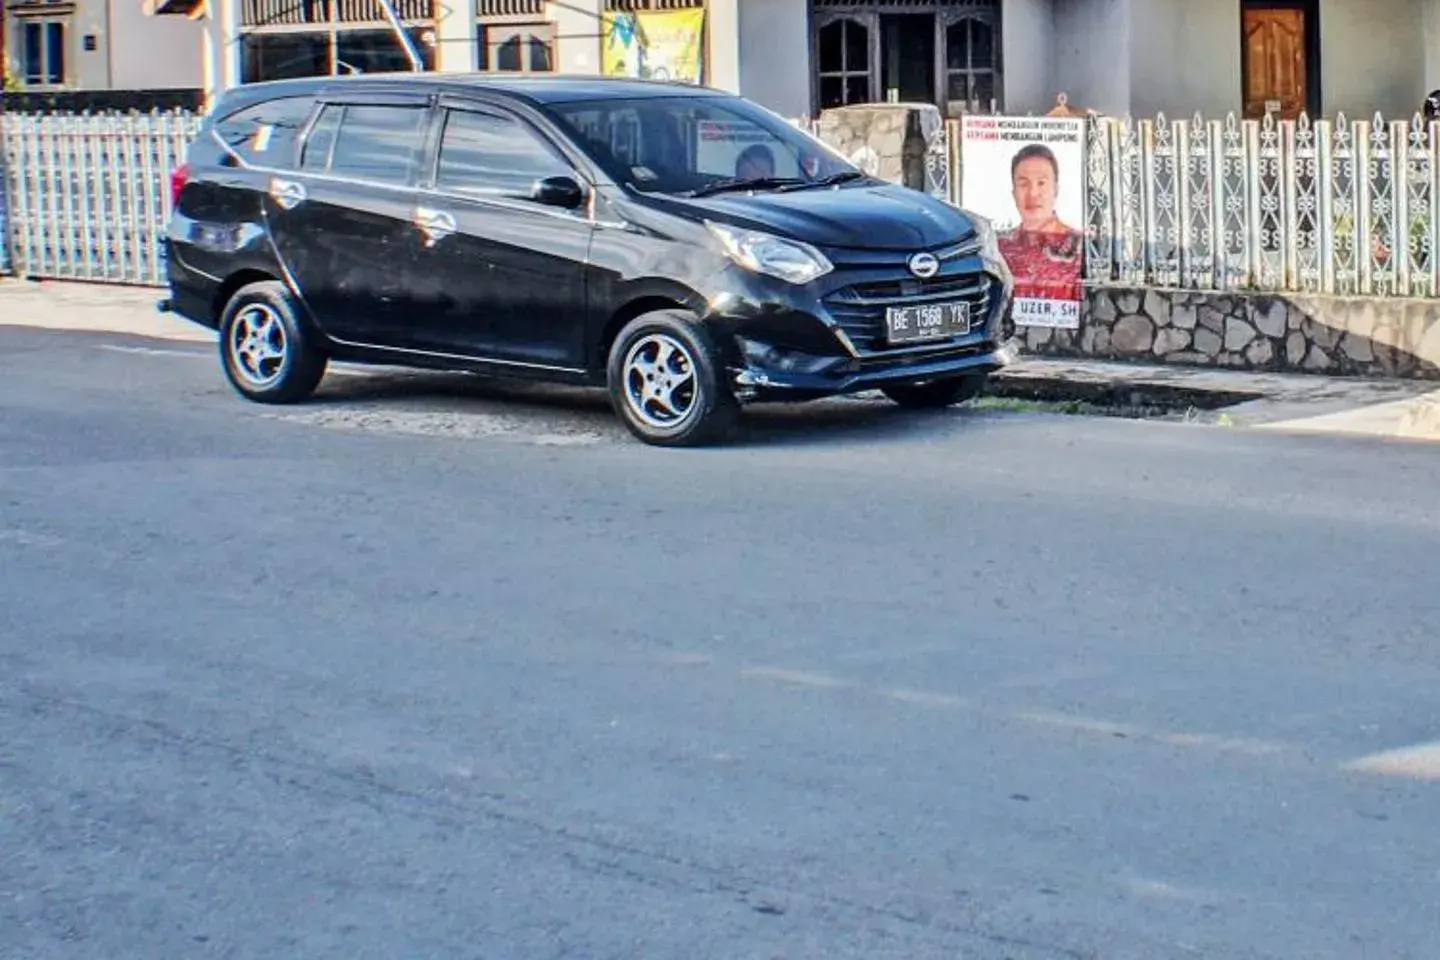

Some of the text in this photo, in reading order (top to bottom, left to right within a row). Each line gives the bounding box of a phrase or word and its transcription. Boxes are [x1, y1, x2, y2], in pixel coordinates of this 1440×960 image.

[894, 310, 909, 331] BE
[950, 304, 965, 323] YK
[1061, 302, 1076, 316] SH
